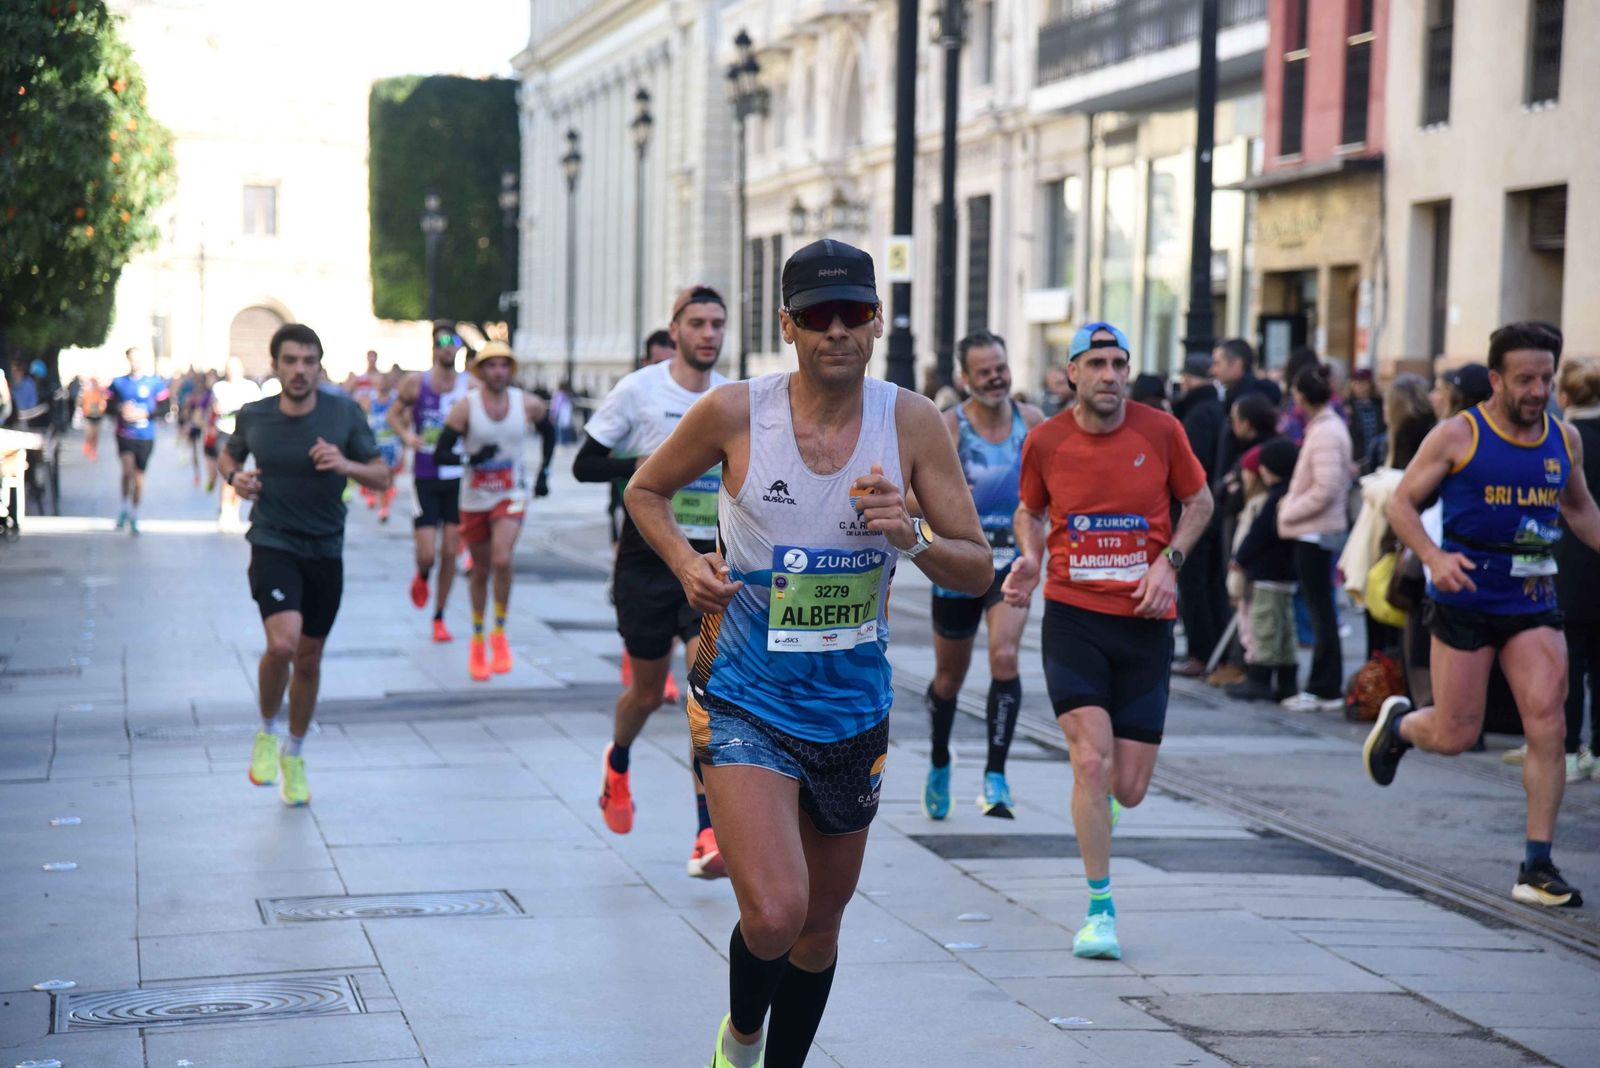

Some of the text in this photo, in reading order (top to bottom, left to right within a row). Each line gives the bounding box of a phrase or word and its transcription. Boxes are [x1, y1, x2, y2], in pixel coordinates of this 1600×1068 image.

[1484, 485, 1559, 507] SRI LANK
[1095, 517, 1140, 528] ZURICH
[1097, 537, 1121, 548] 1173
[815, 551, 876, 569] ZURICH
[814, 585, 850, 598] 3279
[780, 600, 871, 627] ALBERTO
